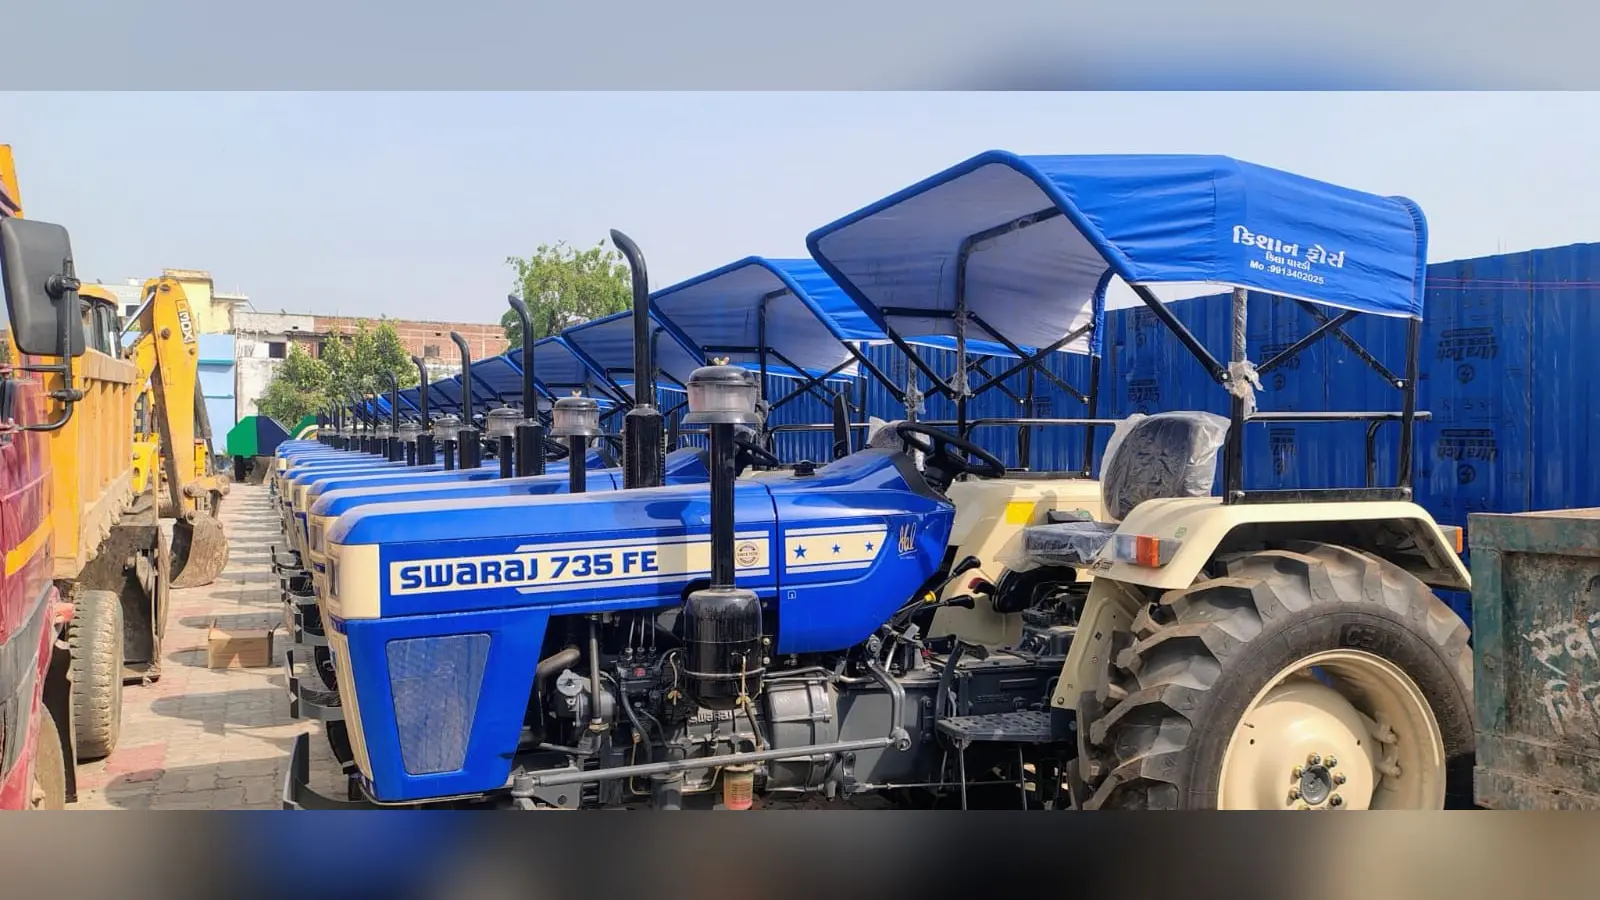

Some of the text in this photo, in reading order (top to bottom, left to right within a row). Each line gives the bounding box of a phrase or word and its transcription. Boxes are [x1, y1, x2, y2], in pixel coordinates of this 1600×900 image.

[1250, 260, 1264, 271] Mo
[550, 553, 613, 579] 735
[623, 550, 659, 574] FE
